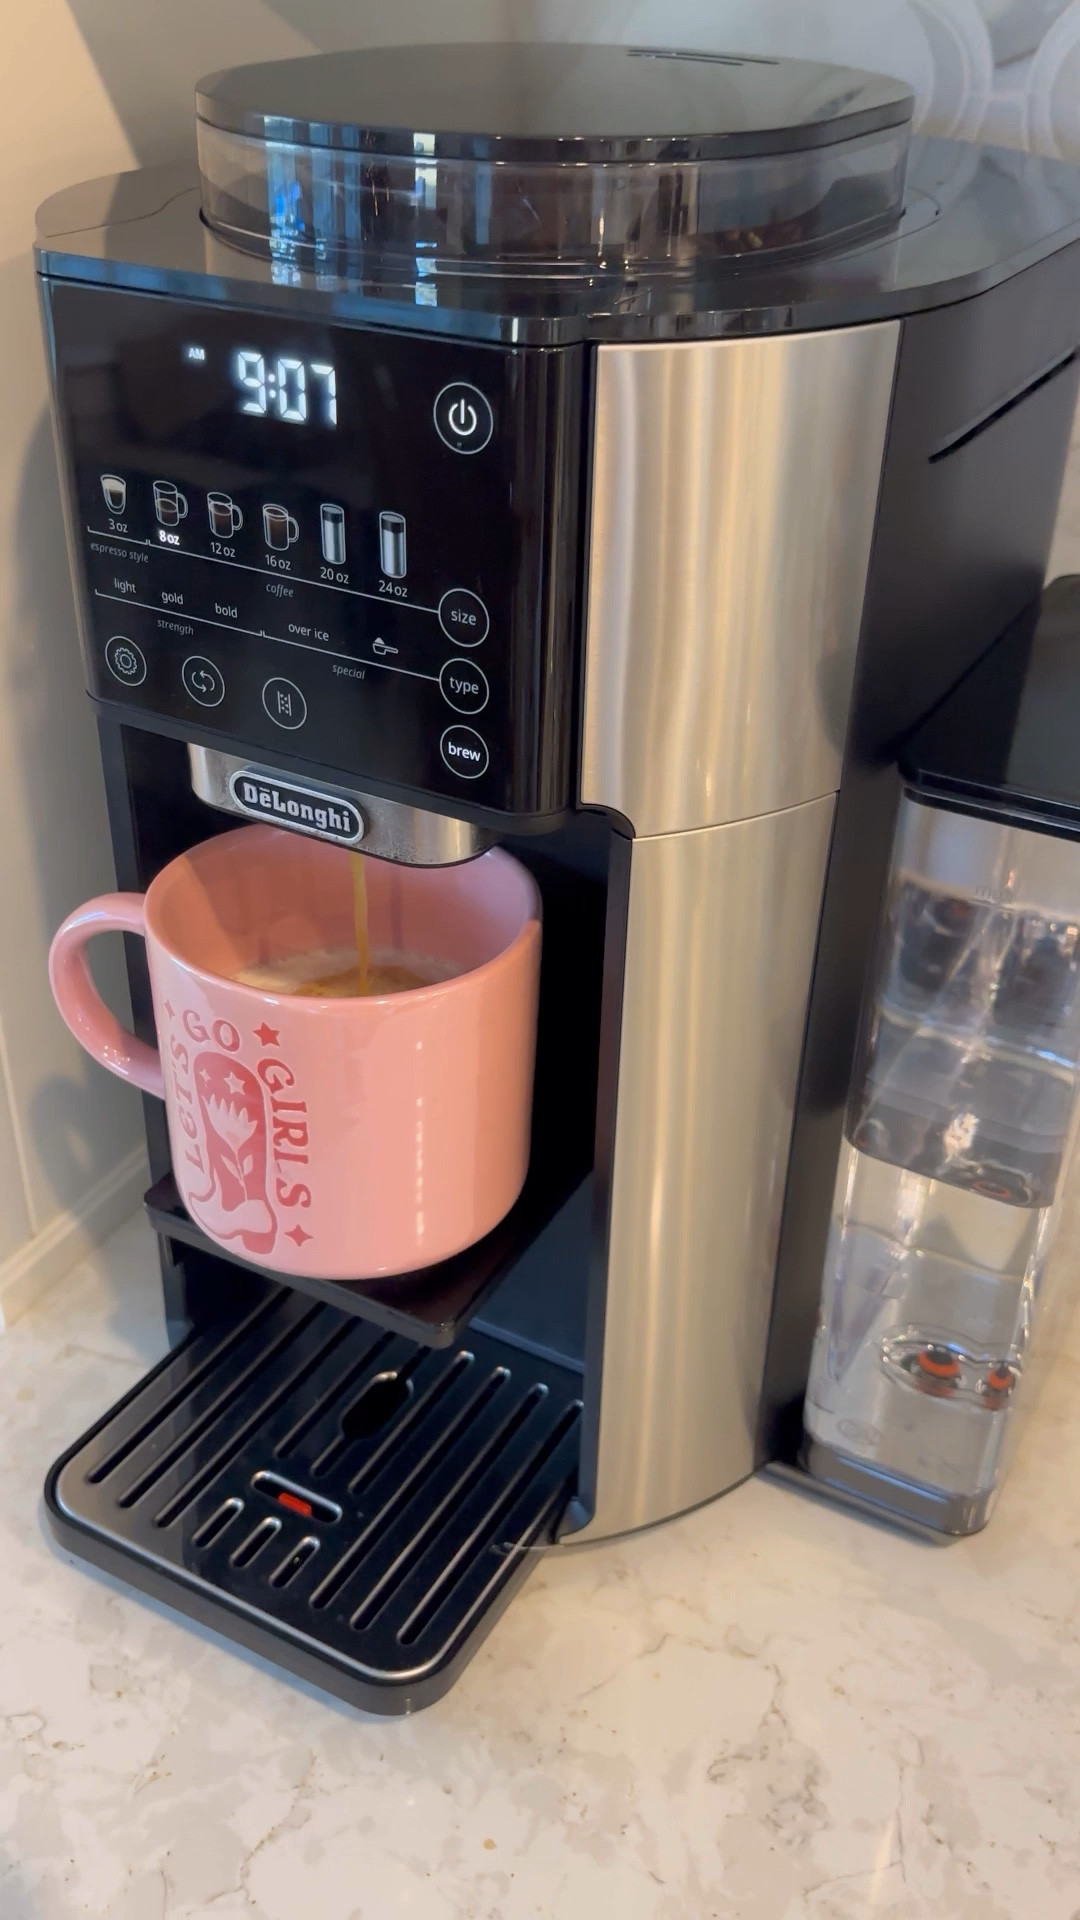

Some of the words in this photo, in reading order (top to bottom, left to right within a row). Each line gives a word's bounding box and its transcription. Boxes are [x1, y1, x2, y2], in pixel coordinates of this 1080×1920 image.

[188, 347, 205, 360] AM
[237, 351, 337, 425] 9:07
[90, 541, 127, 559] espresso
[129, 546, 149, 564] style
[320, 566, 333, 581] 20
[336, 572, 349, 585] oz
[113, 577, 137, 594] light
[265, 583, 294, 598] coffee
[161, 590, 184, 606] gold
[215, 602, 238, 618] bold
[450, 609, 477, 626] size
[157, 619, 194, 636] strength
[288, 623, 311, 637] over
[314, 624, 330, 641] ice
[332, 664, 366, 680] special
[449, 676, 479, 695] type
[448, 741, 481, 762] brew
[182, 1009, 241, 1053] GO
[256, 1058, 312, 1209] GIRLS
